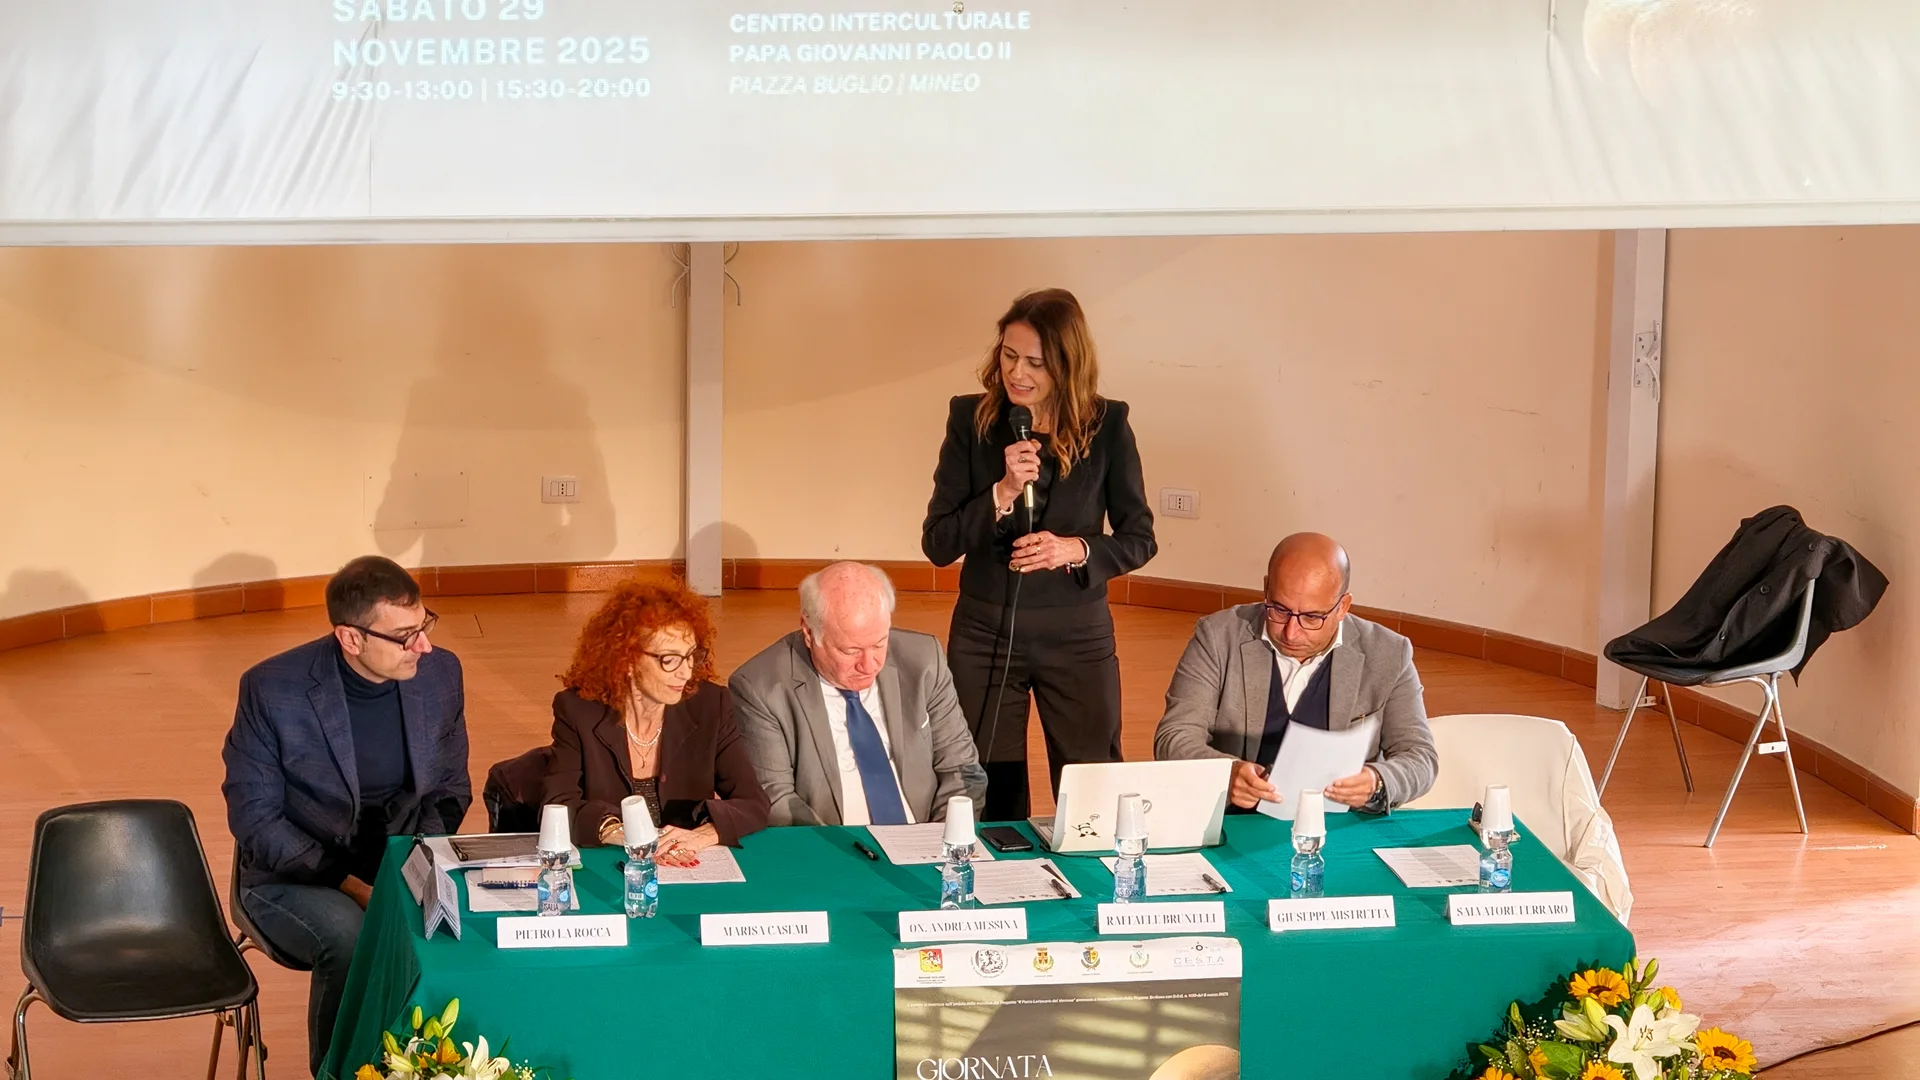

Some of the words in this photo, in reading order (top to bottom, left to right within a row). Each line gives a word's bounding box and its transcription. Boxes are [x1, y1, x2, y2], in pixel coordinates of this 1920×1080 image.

[333, 0, 488, 22] SABATO
[498, 0, 544, 21] 29
[729, 13, 825, 33] CENTRO
[830, 11, 1031, 32] INTERCULTURALE
[332, 38, 547, 67] NOVEMBRE
[556, 36, 650, 64] 2025
[729, 44, 792, 62] PAPA
[797, 43, 910, 62] GIOVANNI
[916, 42, 994, 60] PAOLO
[998, 41, 1011, 60] II
[332, 80, 474, 101] 9:30-13:00
[496, 78, 651, 99] 15:30-20:00
[728, 75, 807, 95] PIAZZA
[813, 74, 894, 94] BUGLIO
[908, 73, 981, 93] MINEO
[1106, 914, 1161, 926] RAFFAELE
[1162, 912, 1216, 924] BRUNELLI
[1277, 910, 1328, 923] GIUSEPPE
[1329, 908, 1390, 920] MISTRETTA
[1456, 905, 1517, 917] SALVATORE
[1518, 904, 1568, 916] FERRARO
[515, 928, 555, 940] PIETRO
[557, 927, 572, 938] LA
[574, 926, 611, 938] ROCCA
[723, 924, 765, 936] MARISA
[909, 922, 928, 933] ON.
[930, 921, 972, 932] ANDREA
[973, 919, 1019, 931] MESSINA
[916, 1054, 1054, 1080] GIORNATA
